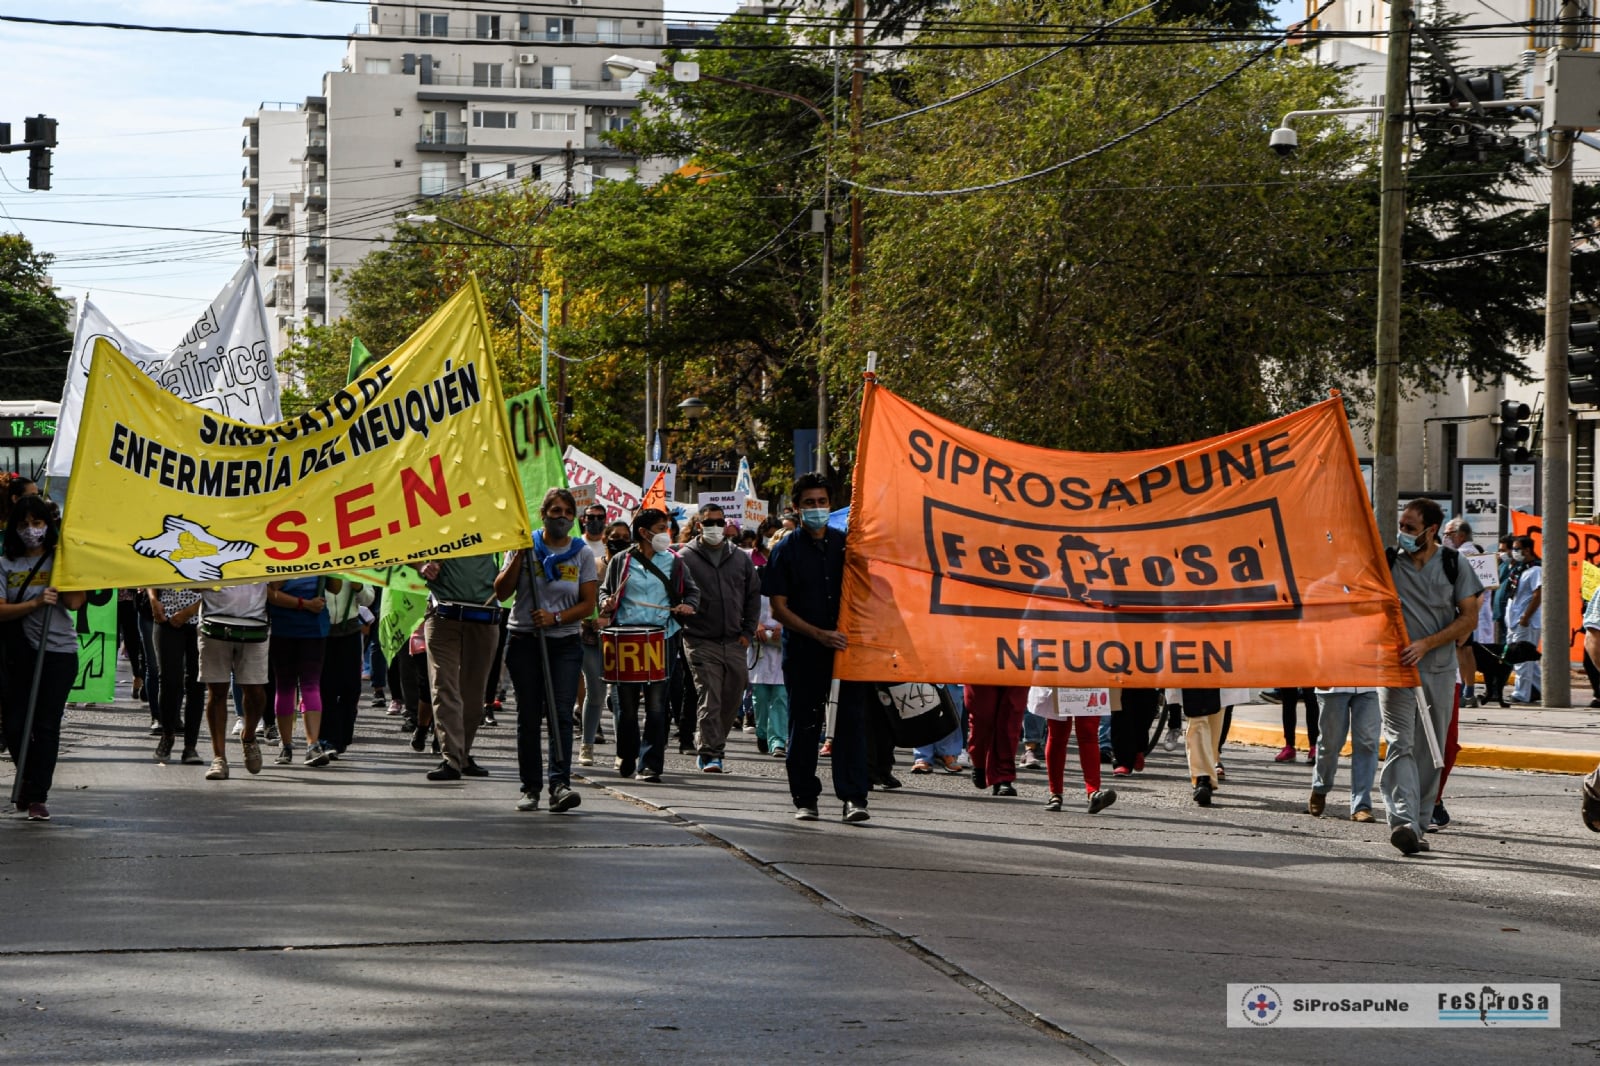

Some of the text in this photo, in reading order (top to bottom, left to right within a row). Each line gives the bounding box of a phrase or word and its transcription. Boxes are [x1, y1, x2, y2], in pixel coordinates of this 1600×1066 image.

[109, 359, 481, 497] ENFERMERÍA DEL NEUQUÉN
[199, 365, 394, 446] SINDICATO DE
[563, 457, 643, 513] GUARD
[907, 428, 1296, 511] SIPROSAPUNE
[263, 453, 472, 561] S.E.N.
[265, 548, 381, 574] SINDICATO DE
[407, 532, 483, 560] NEUQUÉN
[996, 637, 1233, 676] NEUQUEN
